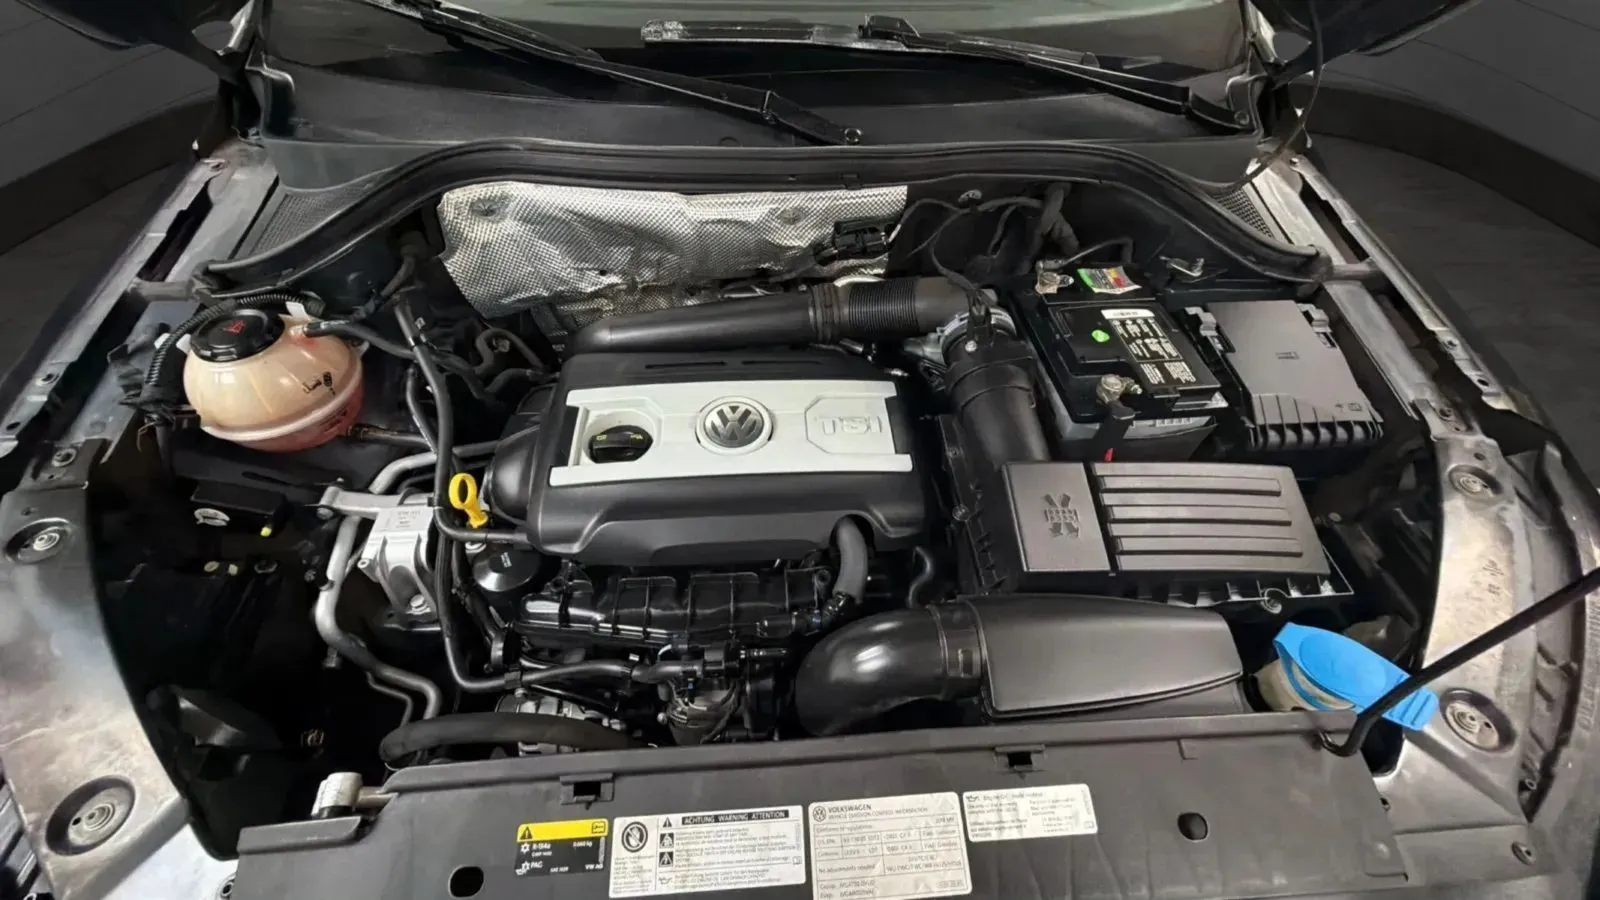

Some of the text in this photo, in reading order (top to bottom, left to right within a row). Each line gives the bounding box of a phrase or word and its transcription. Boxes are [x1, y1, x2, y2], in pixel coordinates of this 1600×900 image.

[816, 415, 882, 435] TSI
[828, 803, 872, 814] VOLKSWAGEN
[684, 811, 786, 825] ACHTUNG WARNING ATTENTION
